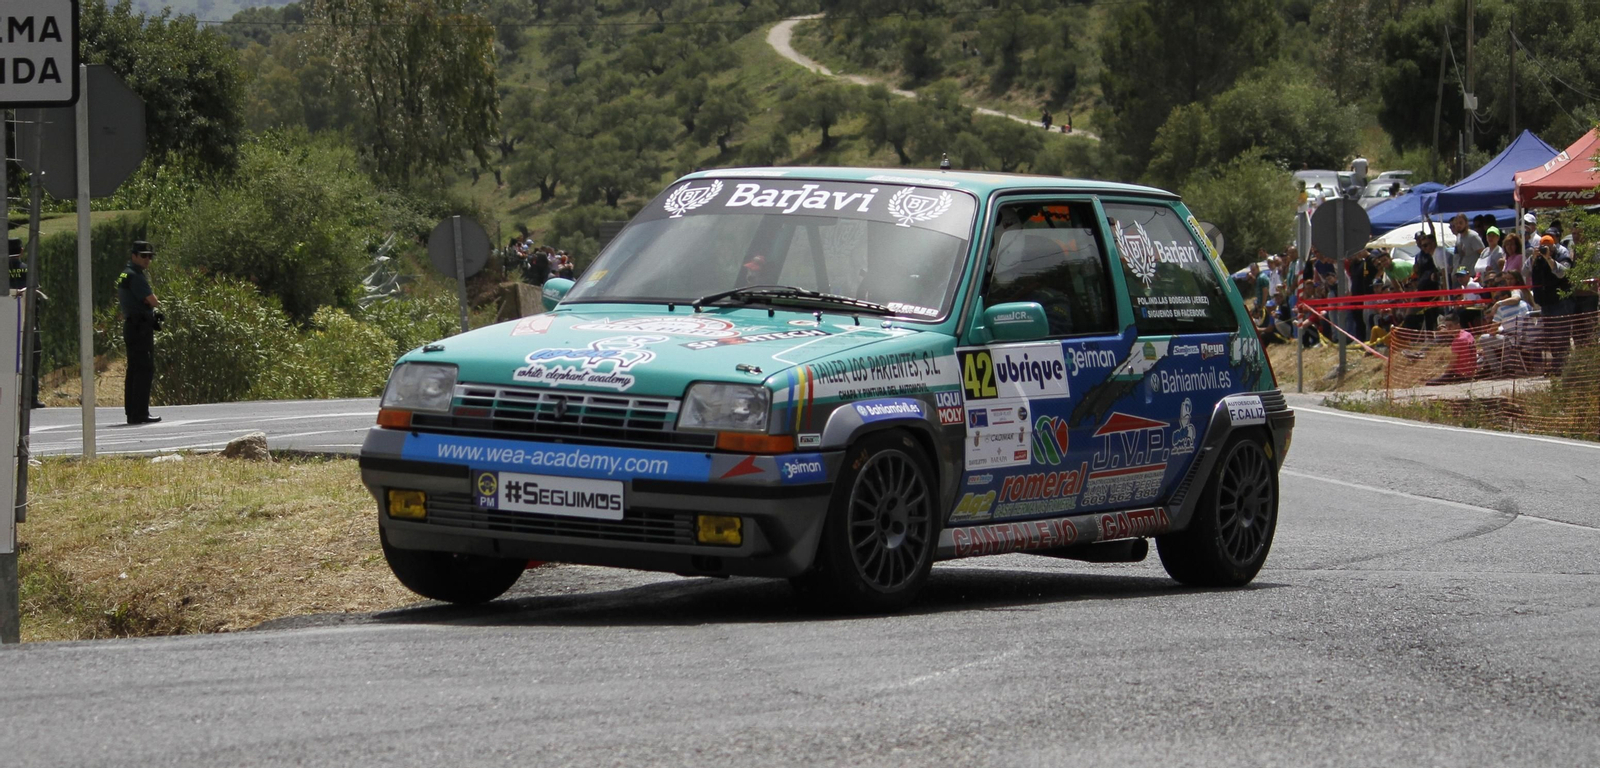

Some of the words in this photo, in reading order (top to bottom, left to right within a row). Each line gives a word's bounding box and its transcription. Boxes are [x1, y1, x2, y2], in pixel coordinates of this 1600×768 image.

[0, 16, 63, 43] MA
[725, 184, 878, 214] BarJavi
[1154, 240, 1199, 268] BarJavi
[517, 365, 543, 379] white
[545, 368, 589, 383] elephant
[588, 372, 632, 387] academy
[811, 358, 850, 385] TALLER
[846, 357, 868, 382] LOS
[868, 352, 923, 381] PARIENTES,
[922, 350, 941, 376] S.L.
[963, 351, 997, 398] 42
[996, 354, 1064, 390] ubrique
[1160, 366, 1232, 394] Bahiamóvil.es
[936, 392, 962, 407] LIQUI
[938, 408, 964, 424] MOLY
[1229, 407, 1265, 421] F.CALIZ
[437, 442, 669, 475] www.wea-academy.com
[998, 462, 1088, 502] romeral
[480, 496, 495, 507] PM
[1081, 494, 1106, 507] 609
[1108, 491, 1133, 504] 562
[1135, 488, 1158, 499] 384
[951, 518, 1078, 556] CANTALEJO
